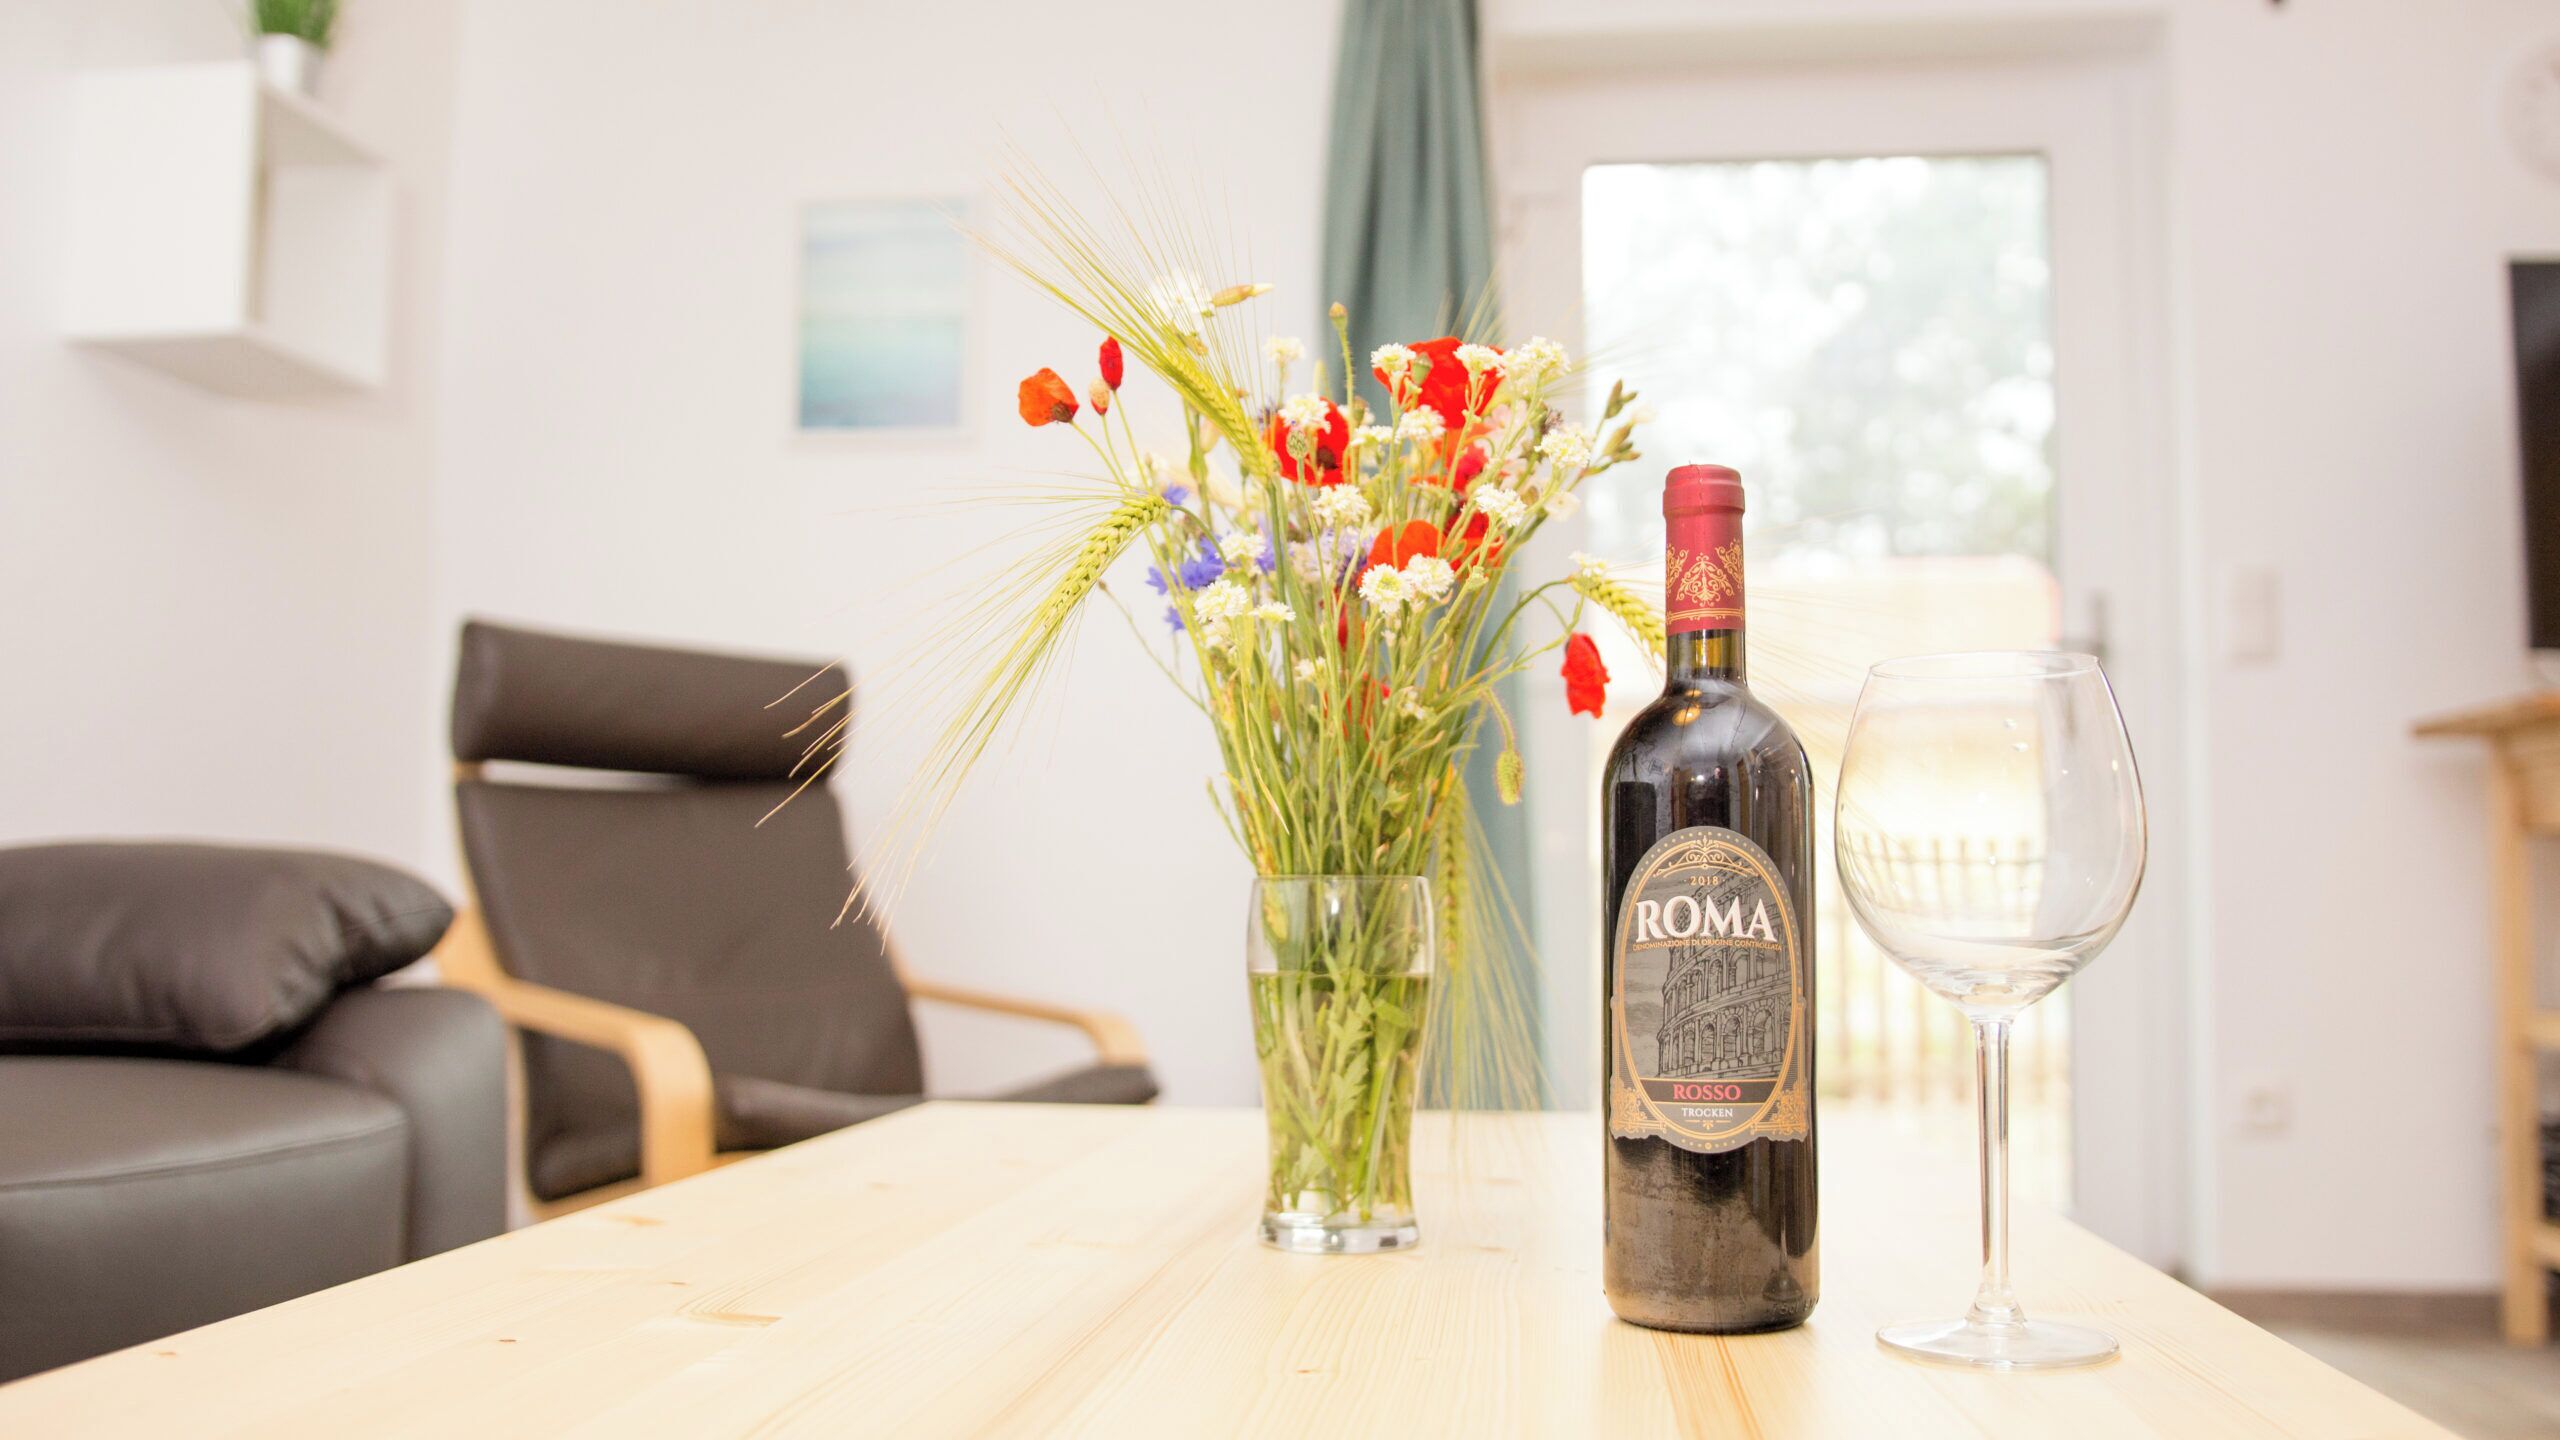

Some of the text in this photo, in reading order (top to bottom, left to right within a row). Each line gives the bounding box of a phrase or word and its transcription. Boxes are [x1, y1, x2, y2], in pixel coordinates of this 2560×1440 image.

[1690, 875, 1719, 886] 2018
[1635, 894, 1778, 943] ROMA
[1632, 939, 1691, 952] DENOMINAZIONE
[1733, 939, 1782, 951] CONTROLLATA
[1672, 1083, 1742, 1101] ROSSO
[1681, 1107, 1734, 1118] TROCKEN
